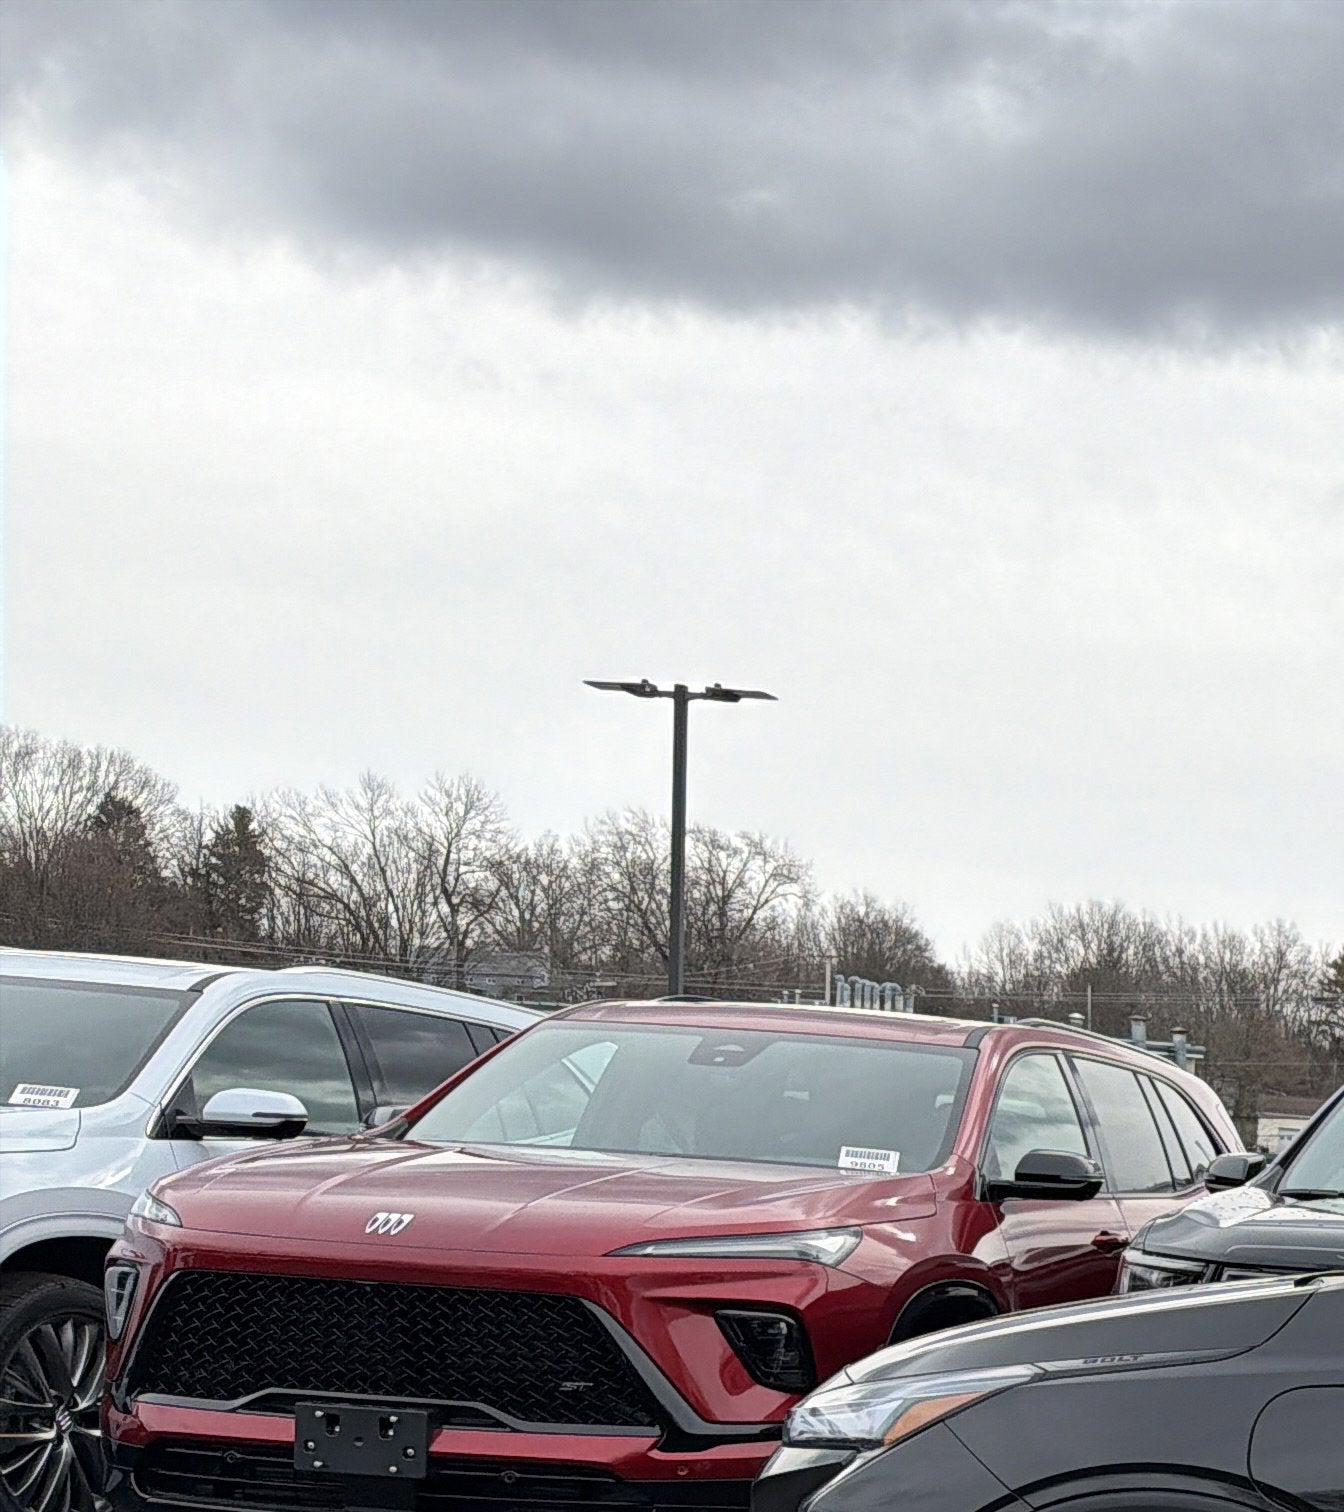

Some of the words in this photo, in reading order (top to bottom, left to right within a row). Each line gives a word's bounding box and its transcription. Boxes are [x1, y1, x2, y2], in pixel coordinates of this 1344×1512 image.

[22, 1097, 60, 1107] 8083
[850, 1160, 885, 1170] 9805
[1082, 1354, 1139, 1365] BOLT
[559, 1381, 595, 1391] ST
